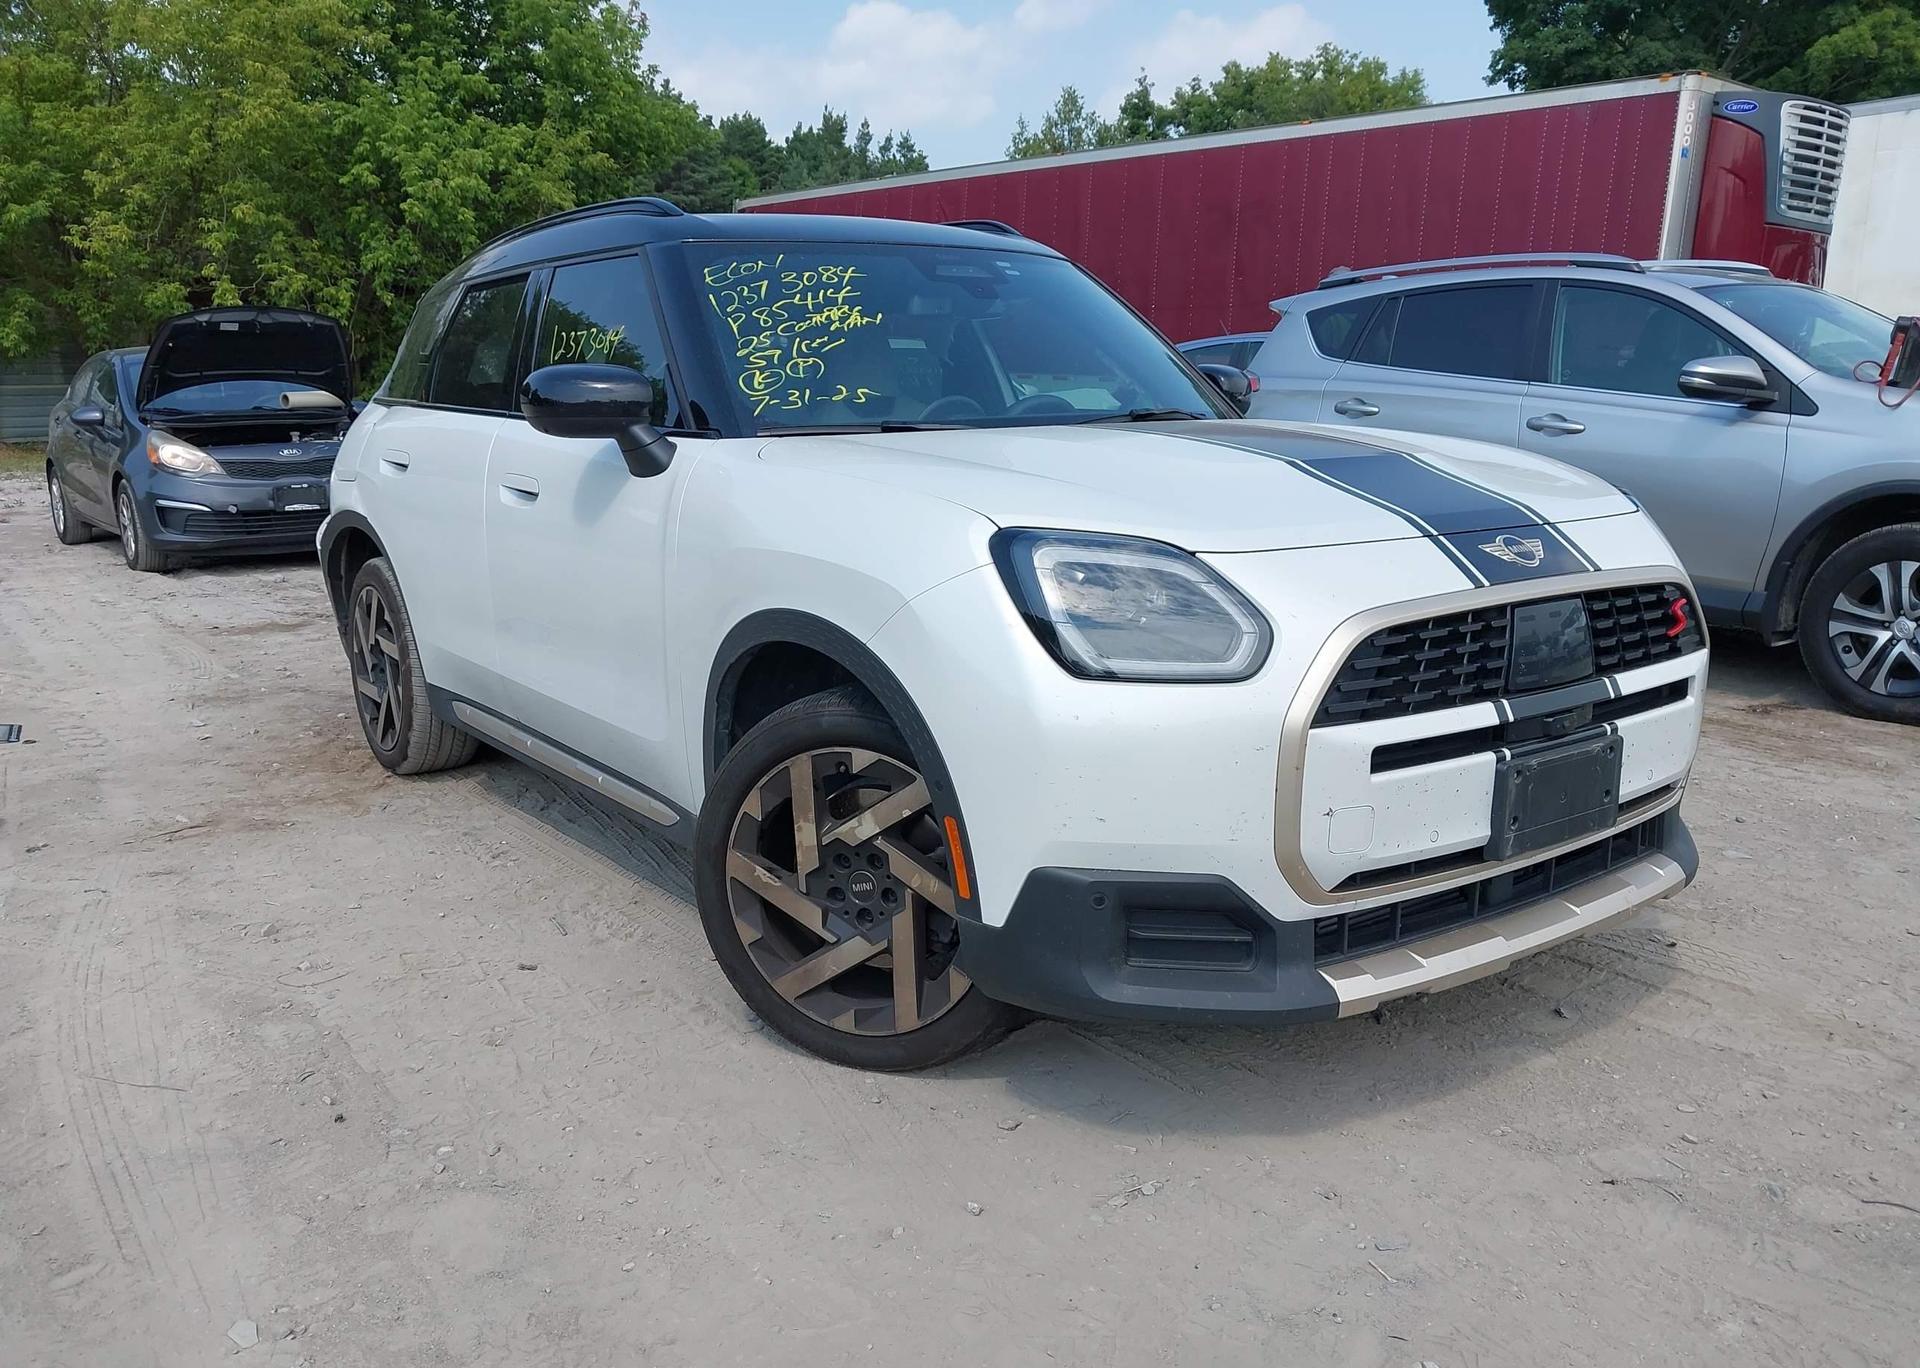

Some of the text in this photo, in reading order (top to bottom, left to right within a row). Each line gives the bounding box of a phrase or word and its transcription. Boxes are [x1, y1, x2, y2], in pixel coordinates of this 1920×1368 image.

[1726, 102, 1756, 111] Carrier
[709, 266, 868, 319] 1237 3084
[550, 324, 625, 365] 12373084
[736, 331, 776, 357] 25
[749, 384, 881, 417] 7-31-25
[1507, 543, 1532, 553] MINI
[852, 882, 873, 892] MINI
